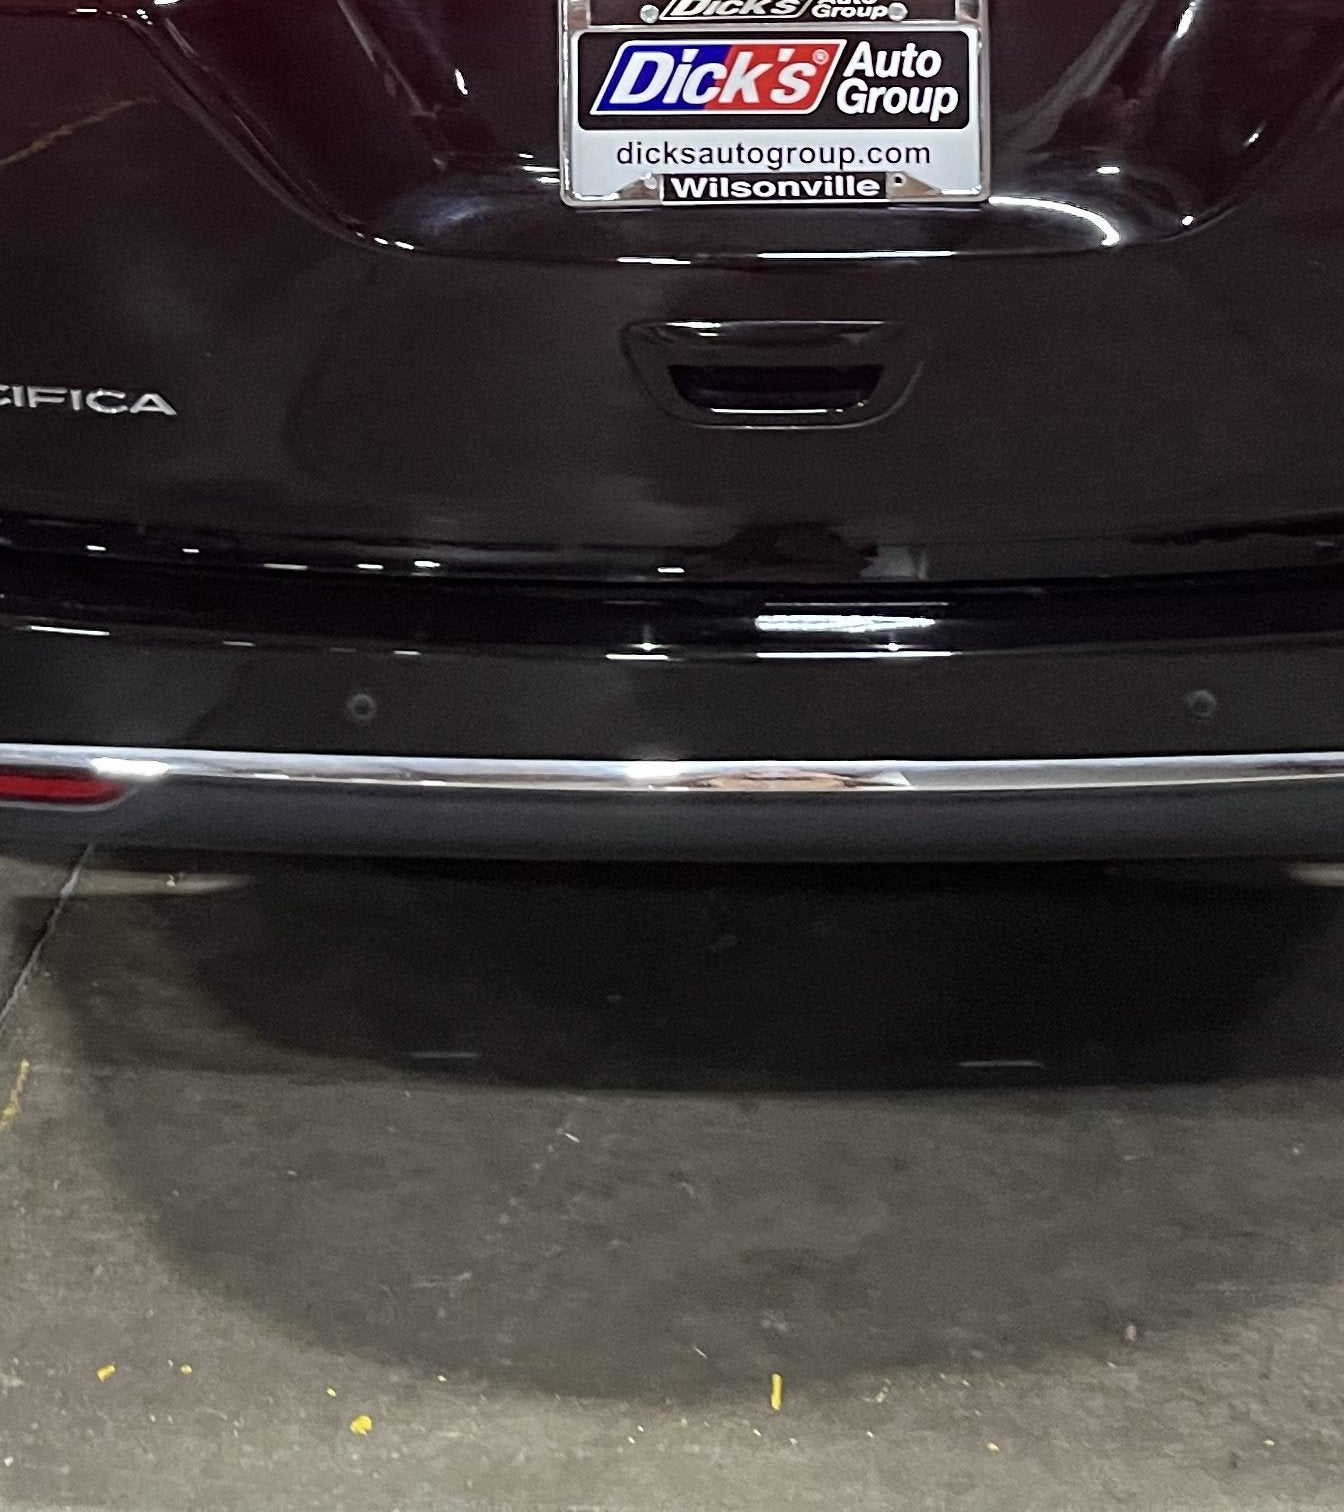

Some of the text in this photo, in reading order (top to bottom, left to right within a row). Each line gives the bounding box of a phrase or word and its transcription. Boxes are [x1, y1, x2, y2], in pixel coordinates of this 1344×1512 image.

[811, 3, 889, 20] Group
[610, 47, 816, 106] Dick's
[843, 40, 942, 79] Auto
[836, 78, 959, 122] Group
[616, 141, 931, 170] dicksautogroup.com
[670, 174, 881, 199] Wilsonville
